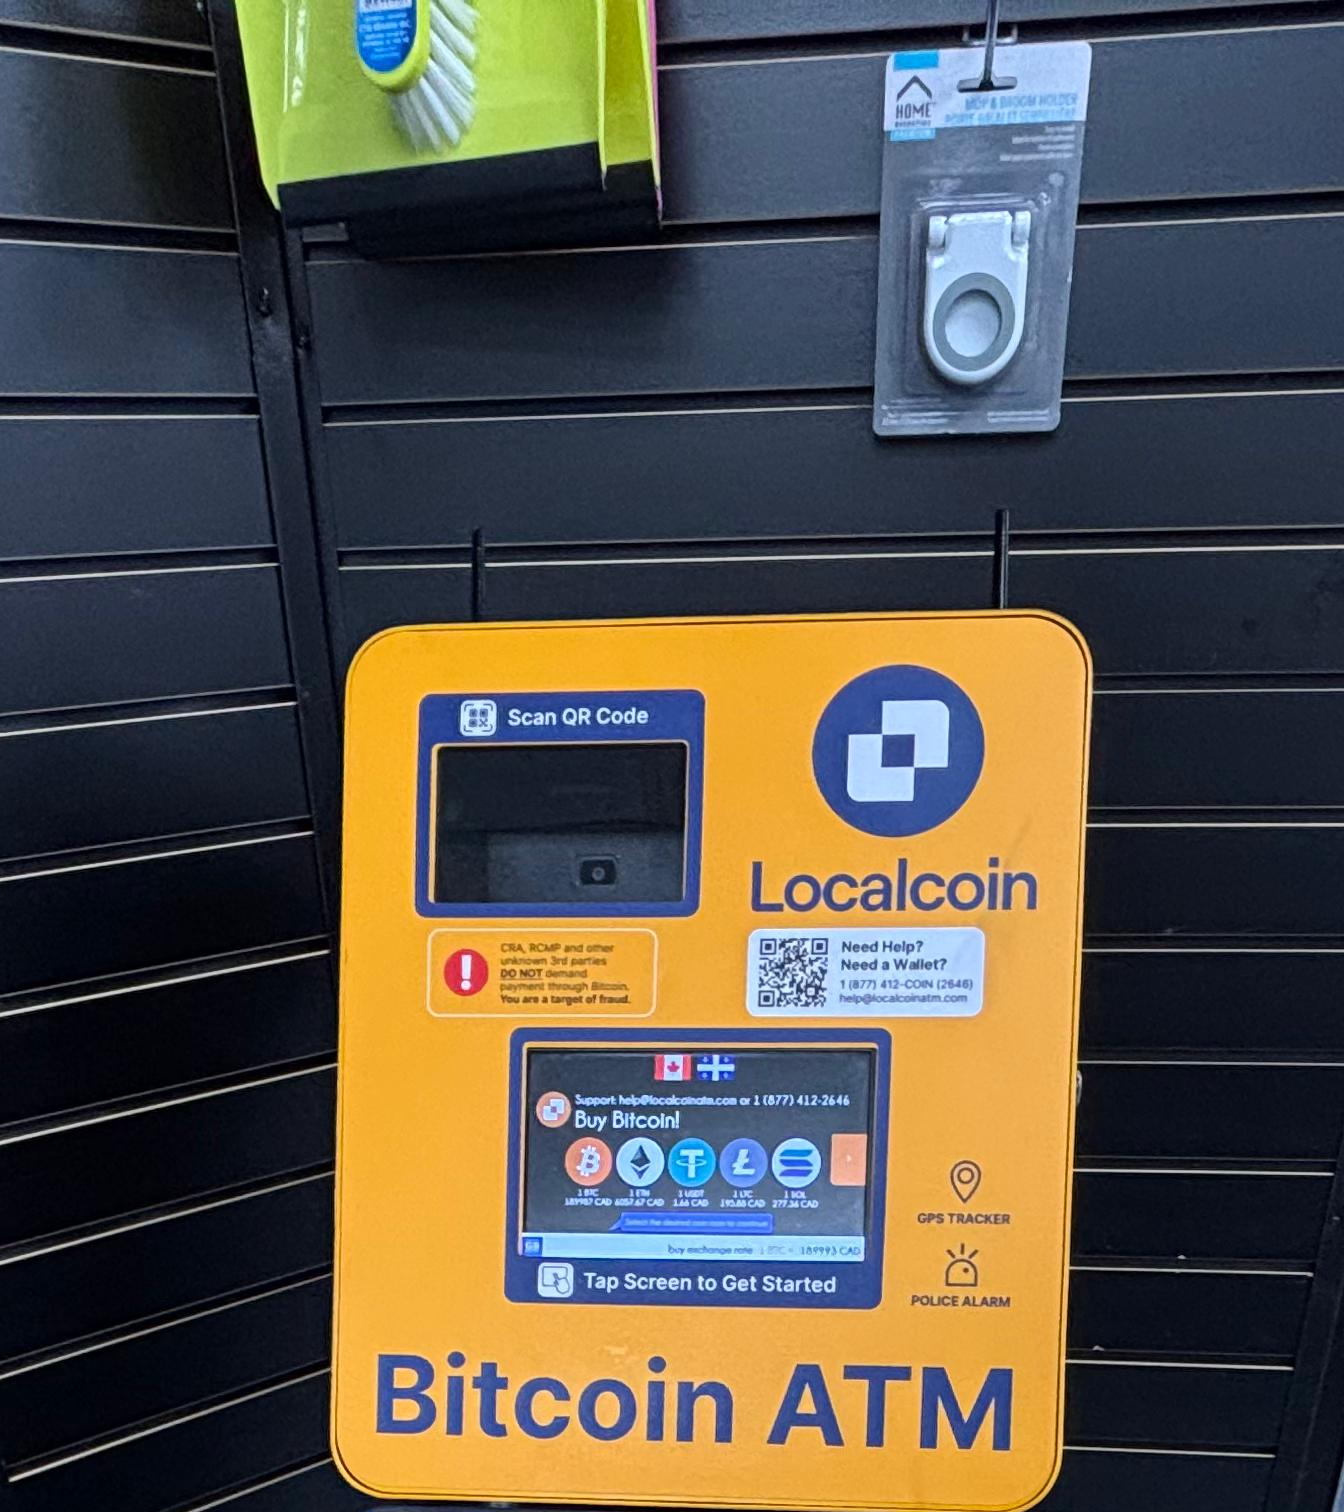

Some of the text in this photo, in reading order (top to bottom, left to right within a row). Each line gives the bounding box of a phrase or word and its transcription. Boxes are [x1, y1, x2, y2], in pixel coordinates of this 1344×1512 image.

[896, 103, 931, 119] HOME
[508, 707, 650, 726] Scan QR Code
[751, 858, 1038, 913] Localcoin
[529, 943, 562, 953] RCMP
[564, 943, 584, 953] and
[586, 944, 615, 953] other
[841, 941, 924, 956] Need Help?
[500, 956, 607, 967] unknown 3rd parties
[841, 958, 948, 971] Need a Wallet?
[500, 969, 588, 979] DO NOT demand
[500, 983, 545, 993] payment
[547, 982, 589, 993] through
[840, 979, 974, 991] 1 (877) 412-COIN (2646)
[500, 994, 520, 1004] You
[522, 996, 539, 1004] are
[542, 996, 549, 1004] a
[550, 995, 583, 1006] target
[585, 994, 597, 1004] of
[739, 1097, 751, 1106] or
[754, 1095, 761, 1106] 1
[762, 1095, 795, 1107] (877)
[796, 1095, 851, 1106] 412-2646
[574, 1110, 680, 1132] Buy Bitcoin!
[594, 1198, 613, 1206] CAD
[646, 1199, 665, 1207] CAD
[690, 1199, 709, 1208] CAD
[747, 1199, 766, 1208] CAD
[800, 1200, 820, 1209] CAD
[917, 1212, 1011, 1224] GPS TRACKER
[667, 1244, 685, 1255] buy
[839, 1247, 861, 1256] CAD
[584, 1272, 837, 1293] Tap Screen to Get Started
[911, 1294, 1011, 1307] POLICE ALARM
[376, 1351, 1014, 1451] Bitcoin ATM
